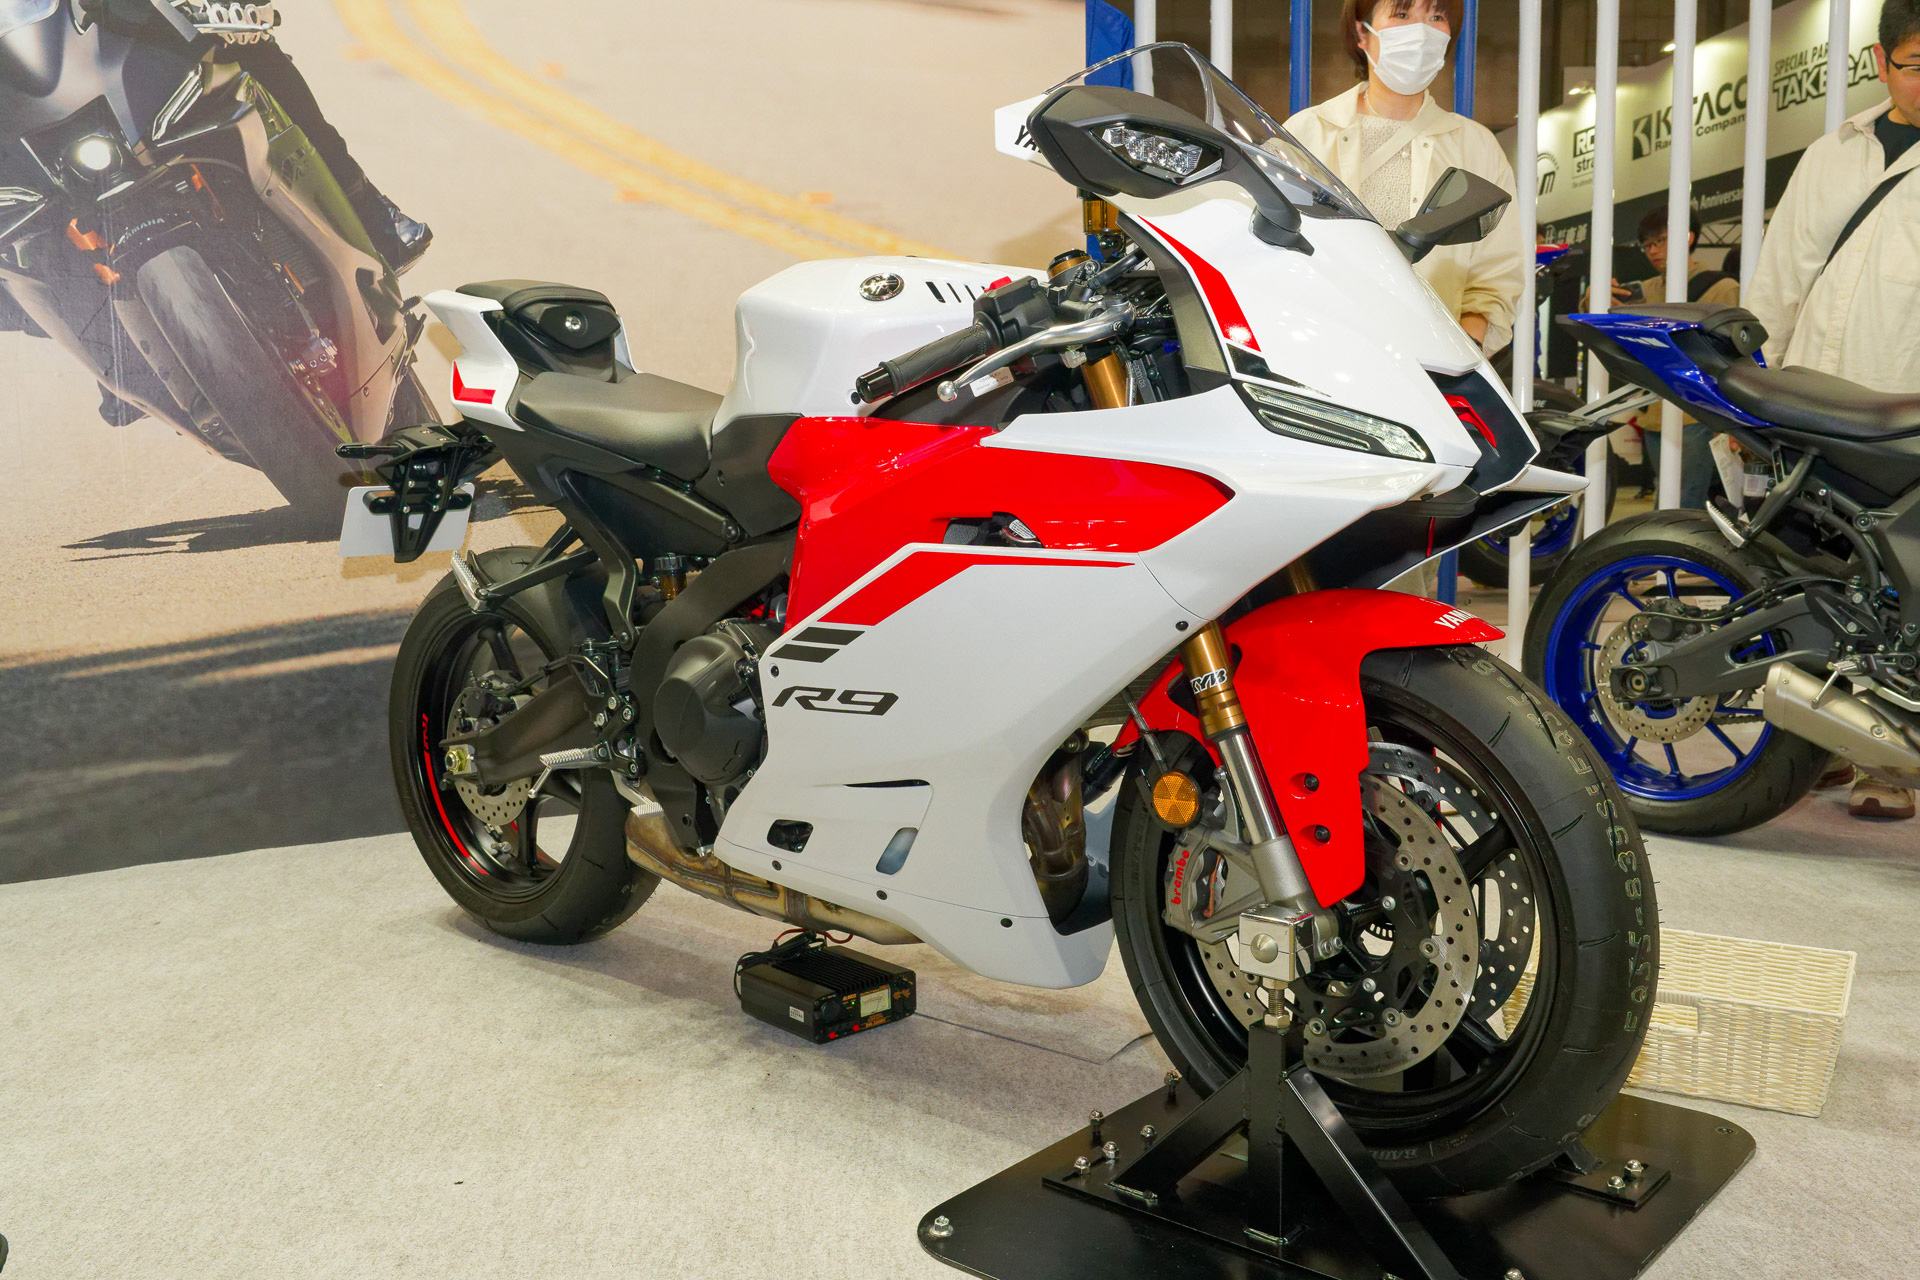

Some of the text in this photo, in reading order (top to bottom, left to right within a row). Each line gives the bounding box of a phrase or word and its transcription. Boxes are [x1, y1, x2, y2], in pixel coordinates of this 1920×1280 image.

[1695, 114, 1746, 138] Compan
[771, 685, 900, 716] R9
[1170, 849, 1190, 905] brembo
